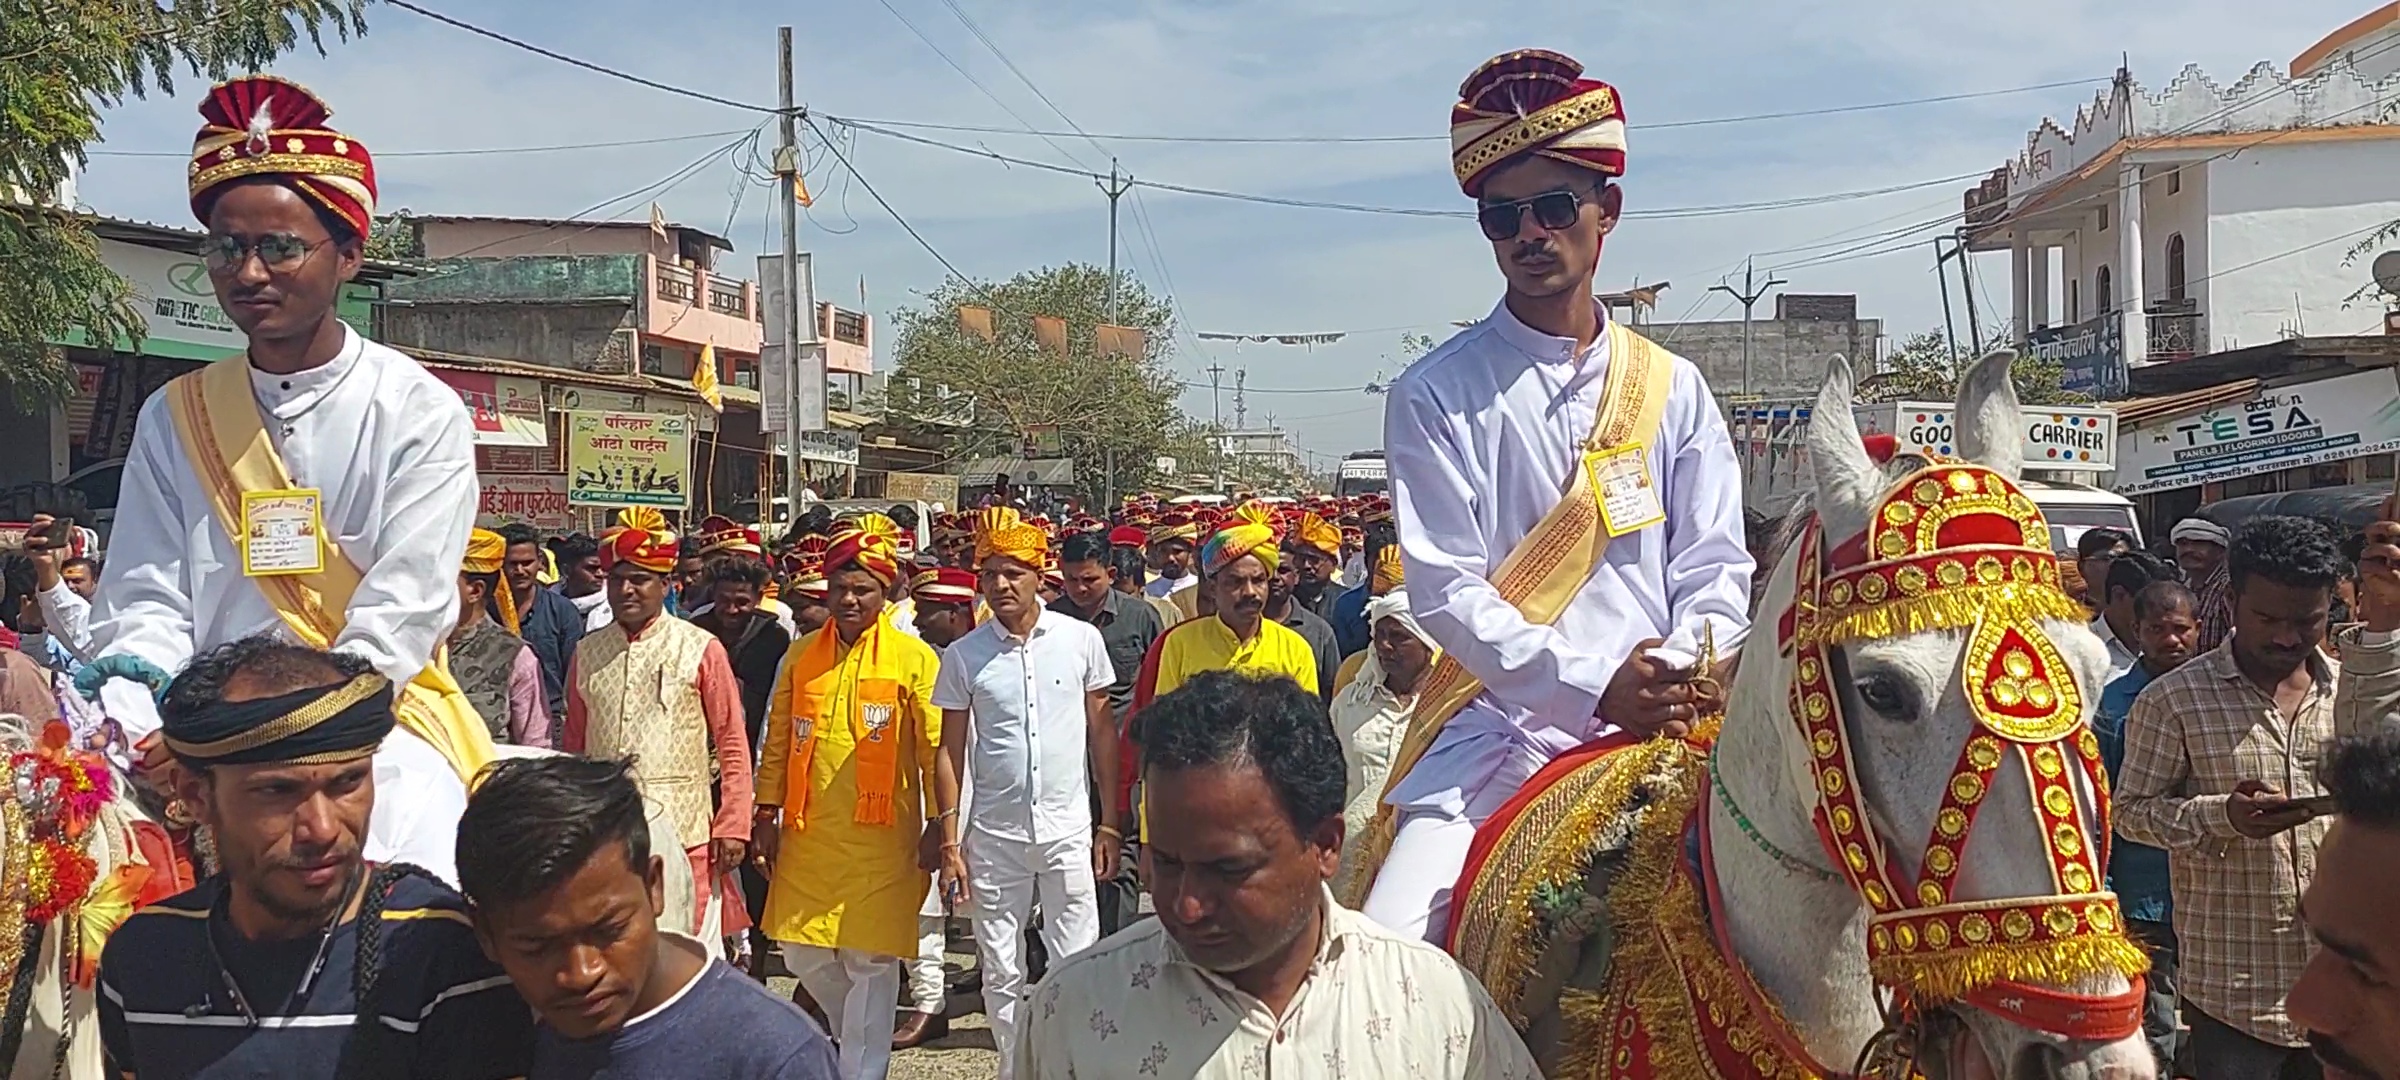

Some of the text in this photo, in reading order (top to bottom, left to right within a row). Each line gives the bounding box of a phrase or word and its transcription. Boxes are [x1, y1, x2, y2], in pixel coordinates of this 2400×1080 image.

[155, 297, 200, 320] KINETIC
[2243, 394, 2303, 413] action
[604, 414, 655, 433] परिहार
[2176, 406, 2313, 446] TESA
[590, 434, 624, 450] ऑटो
[1909, 422, 2104, 451] GOO CARRIER
[2179, 429, 2317, 460] PANELS FLOORING DOORS
